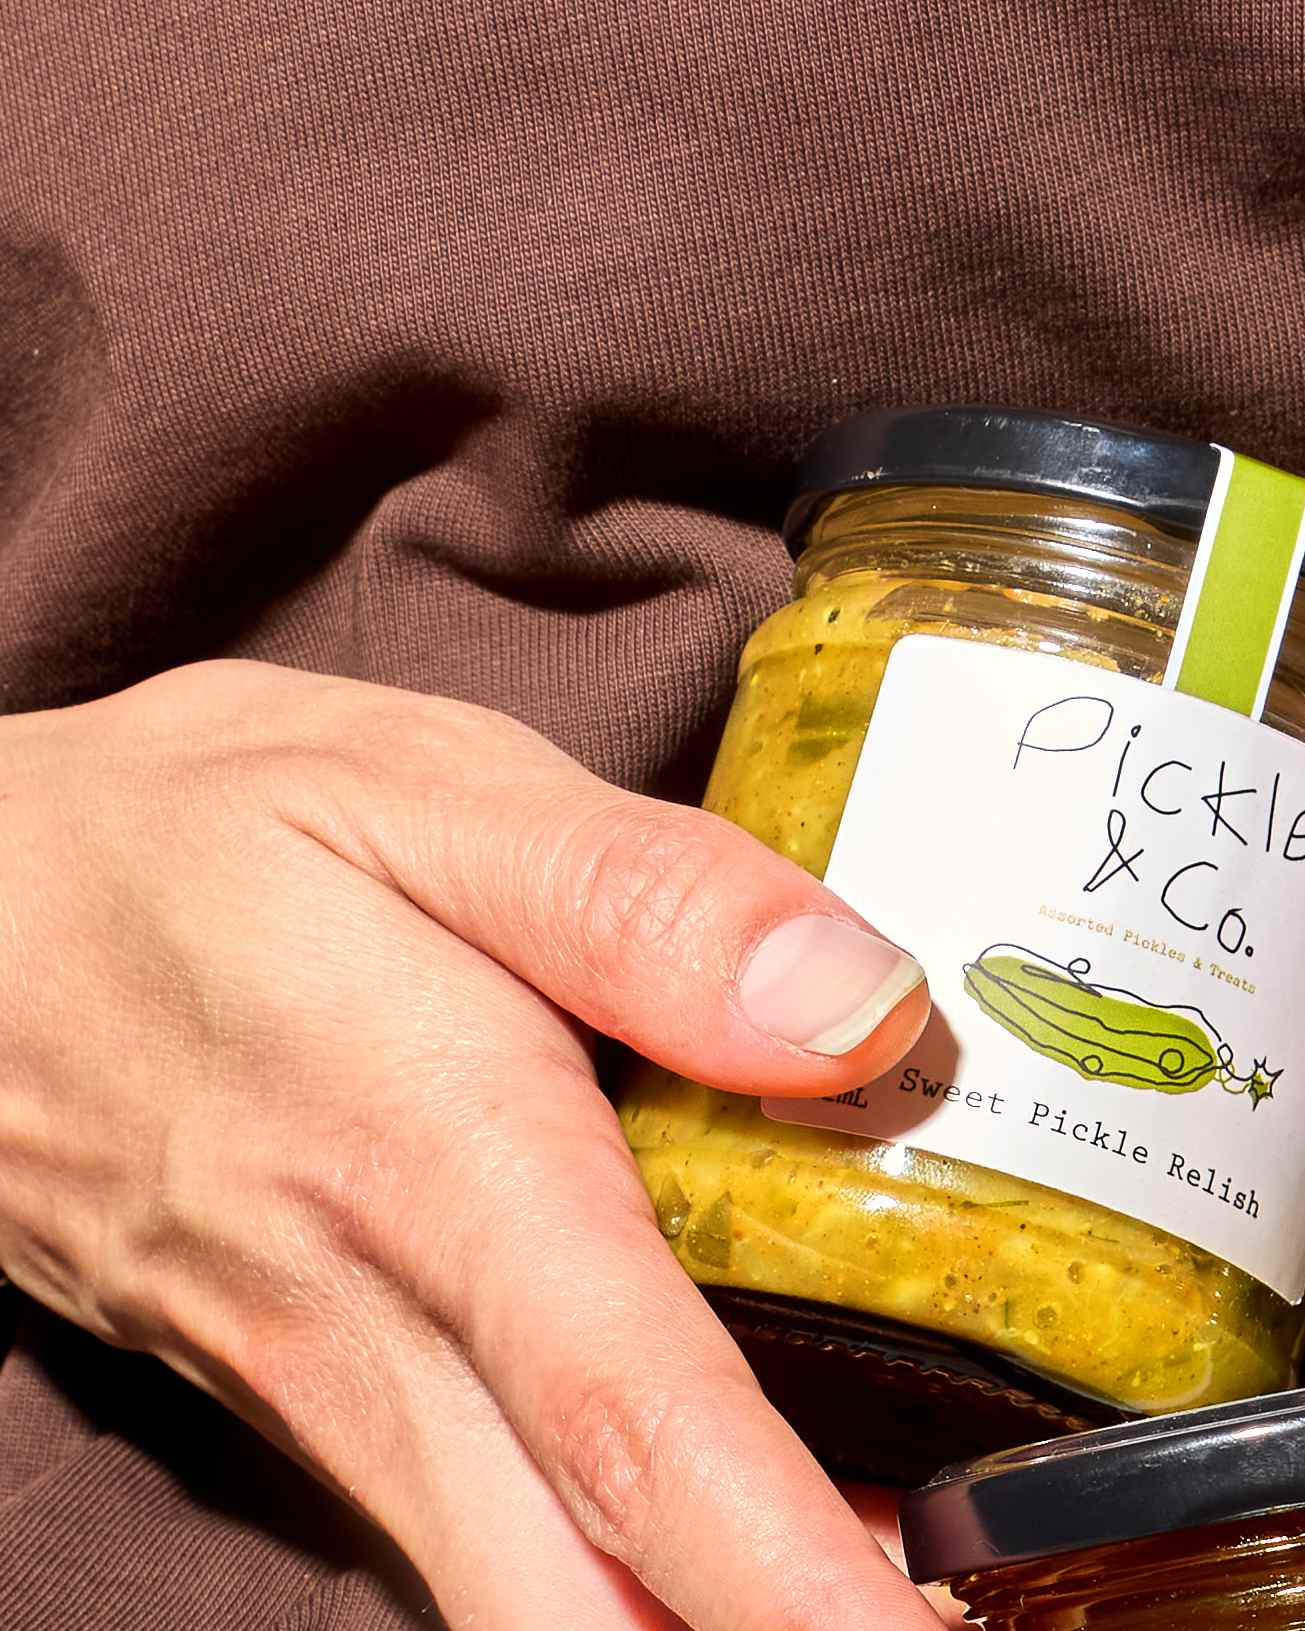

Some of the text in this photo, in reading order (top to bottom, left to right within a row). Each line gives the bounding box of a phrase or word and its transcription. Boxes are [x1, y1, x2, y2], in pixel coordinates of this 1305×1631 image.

[1038, 904, 1256, 995] Assorted Pickles & Treats
[1083, 809, 1254, 957] & Co.
[899, 1067, 1261, 1219] Sweet Pickle Relish
